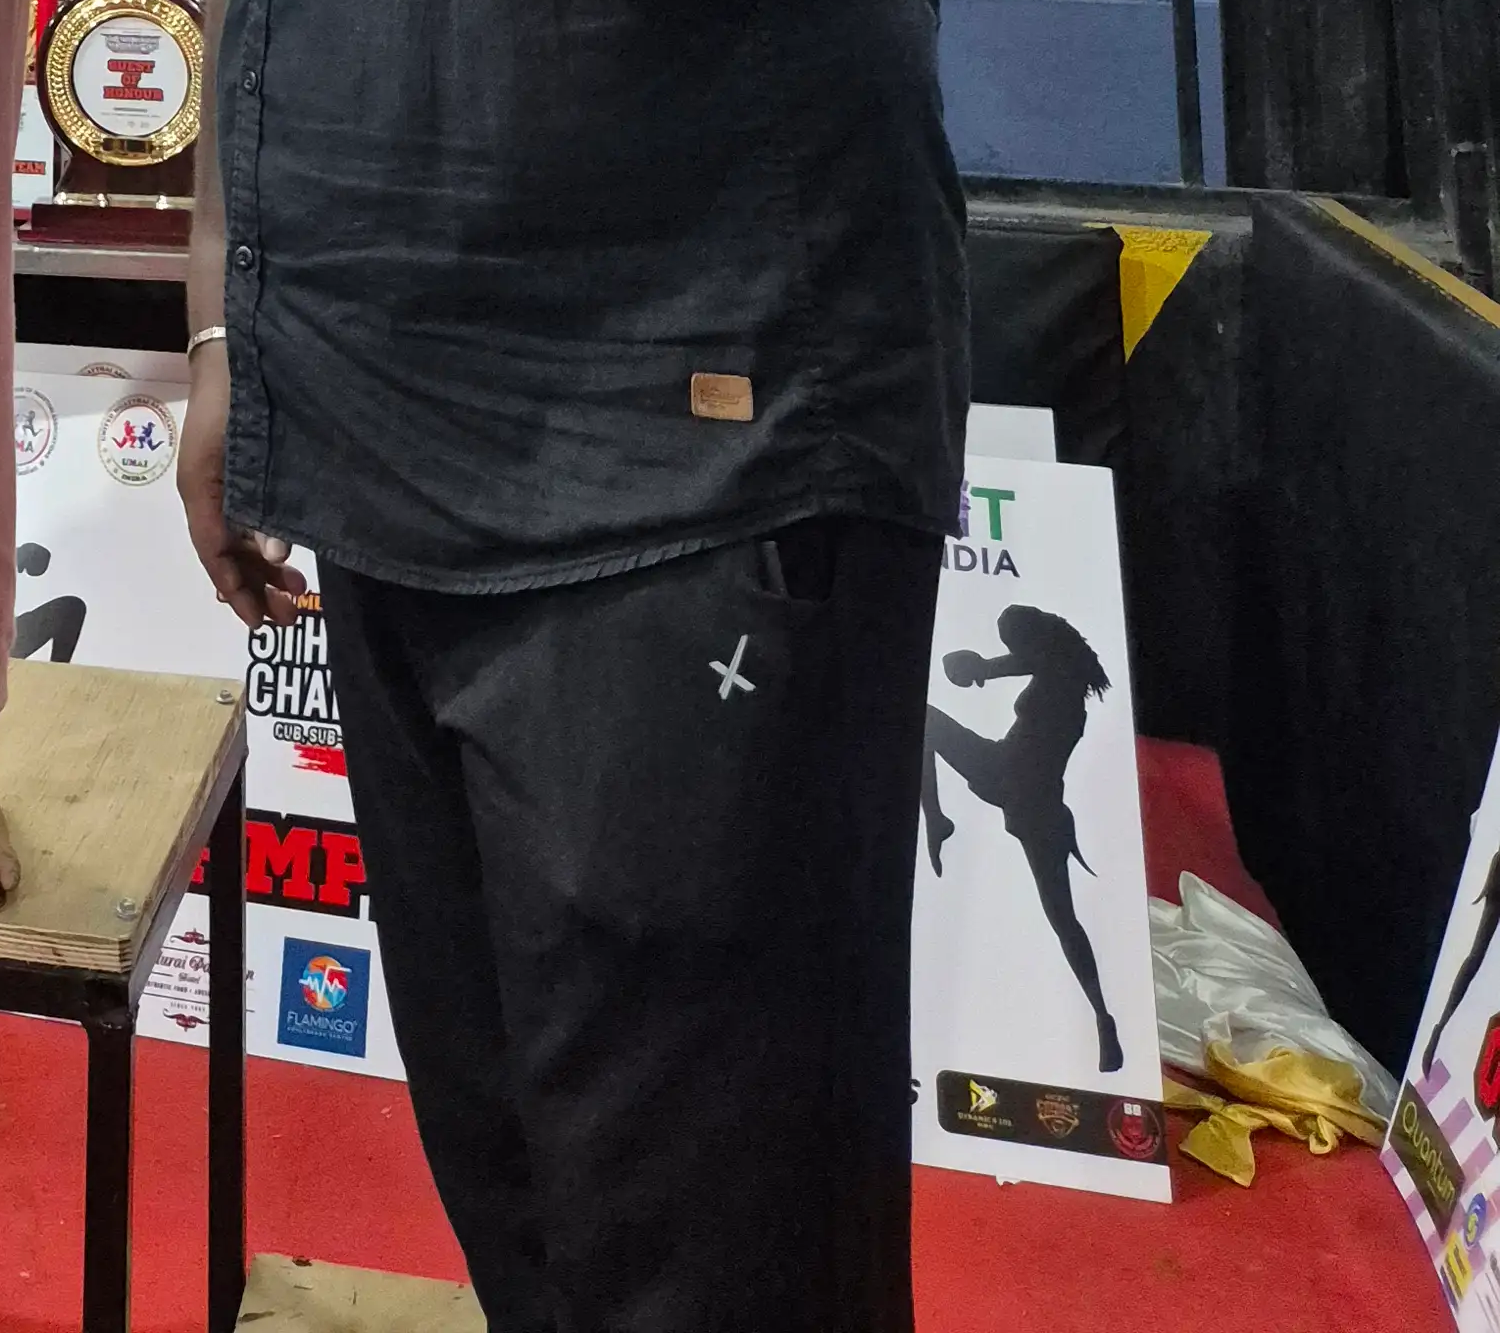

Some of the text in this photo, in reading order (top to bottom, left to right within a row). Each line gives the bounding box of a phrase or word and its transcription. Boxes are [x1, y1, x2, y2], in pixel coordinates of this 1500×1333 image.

[121, 73, 141, 87] OF
[249, 663, 340, 720] CHA
[287, 1011, 355, 1034] FLAMINGO
[1402, 1099, 1457, 1206] Quantum
